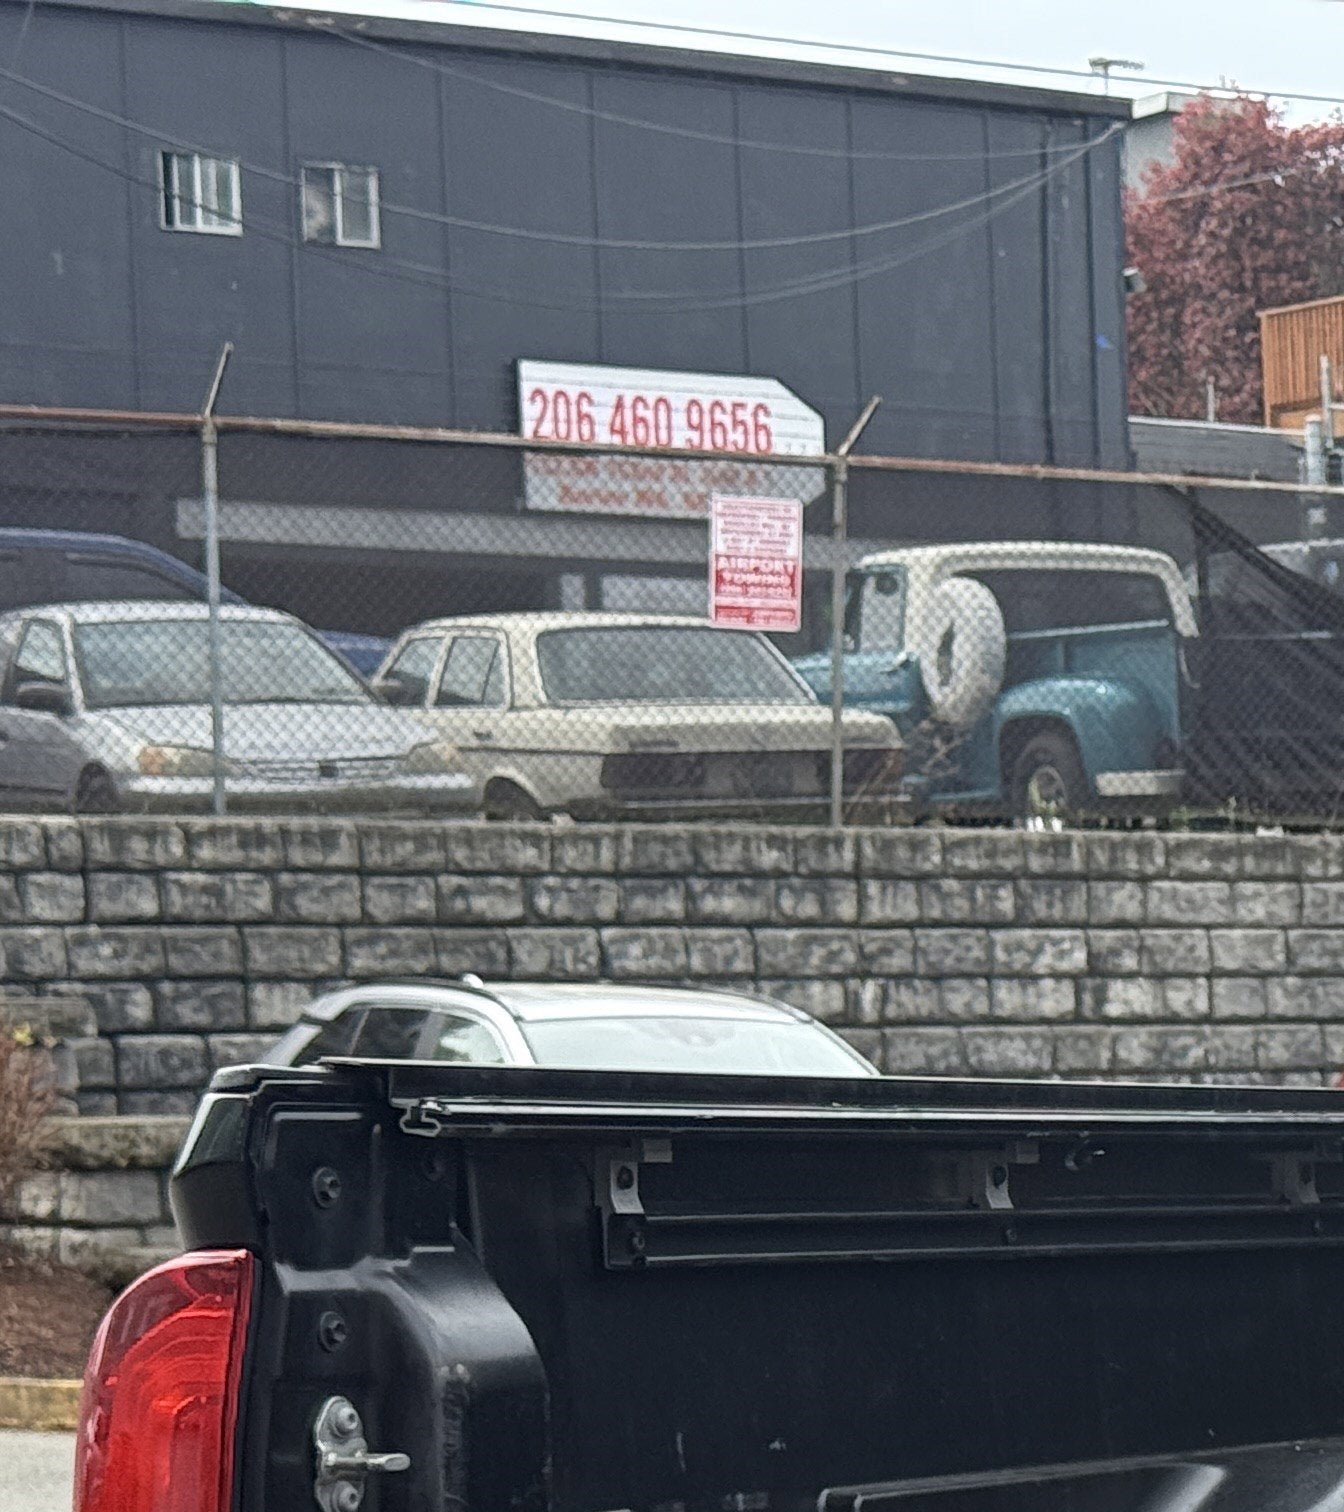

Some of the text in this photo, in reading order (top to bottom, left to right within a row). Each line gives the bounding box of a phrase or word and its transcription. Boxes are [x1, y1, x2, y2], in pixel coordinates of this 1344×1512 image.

[530, 388, 774, 453] 206 460 9656
[717, 557, 796, 574] AIRPORT
